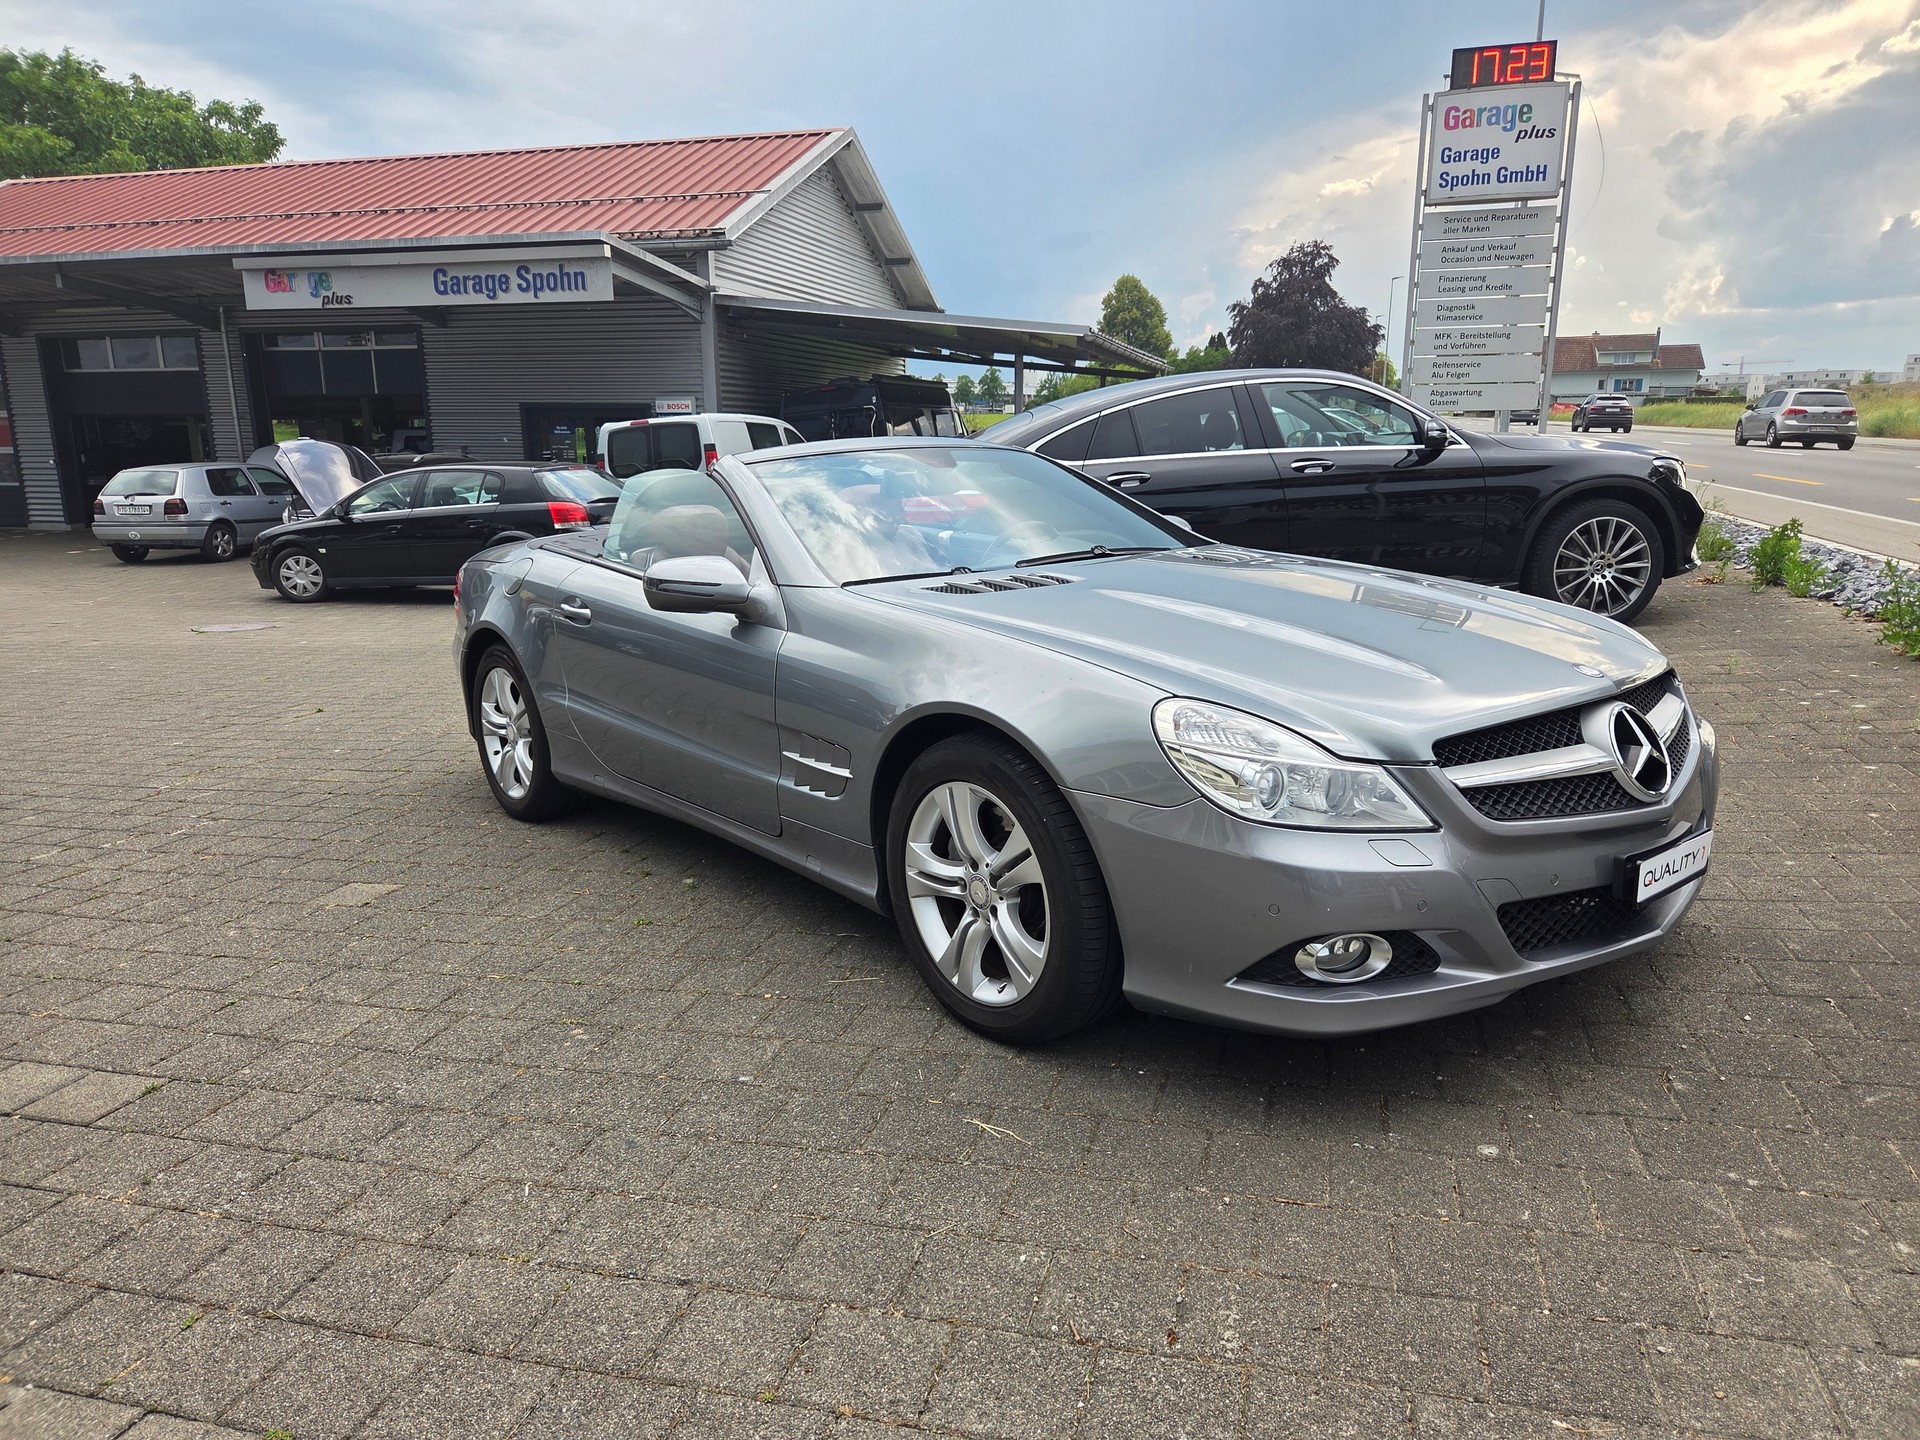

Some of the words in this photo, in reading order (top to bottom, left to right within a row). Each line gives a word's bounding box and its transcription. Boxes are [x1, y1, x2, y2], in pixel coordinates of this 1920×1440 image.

[1443, 103, 1532, 132] Garage
[1514, 125, 1556, 143] plus
[1440, 146, 1500, 164] Garage
[1438, 169, 1490, 191] Spohn
[1496, 164, 1548, 184] GmbH
[1444, 216, 1472, 224] Service
[1474, 214, 1489, 222] und
[1491, 212, 1538, 222] Reparaturen
[1442, 226, 1460, 234] aller
[1462, 225, 1490, 233] Marken
[1470, 244, 1485, 252] und
[1487, 243, 1516, 251] Verkauf
[1441, 255, 1476, 264] Occasion
[1477, 254, 1492, 262] und
[1494, 253, 1534, 262] Neuwagen
[433, 268, 511, 300] Garage
[516, 264, 588, 298] Spohn
[1438, 274, 1487, 283] Finanzierung
[1438, 285, 1466, 293] Leasing
[1468, 284, 1483, 292] und
[1485, 283, 1513, 291] Kredite
[322, 292, 353, 308] plus
[1437, 304, 1476, 313] Diagnostik
[1436, 313, 1484, 321] Klimaservice
[1434, 332, 1452, 340] MFK
[1459, 331, 1512, 340] Bereitstellung
[1450, 341, 1486, 350] Vorführen
[1432, 361, 1482, 369] Reifenservice
[1446, 371, 1470, 380] Felgen
[1430, 389, 1482, 397] Abgaswartung
[1644, 848, 1700, 887] QUALITY
